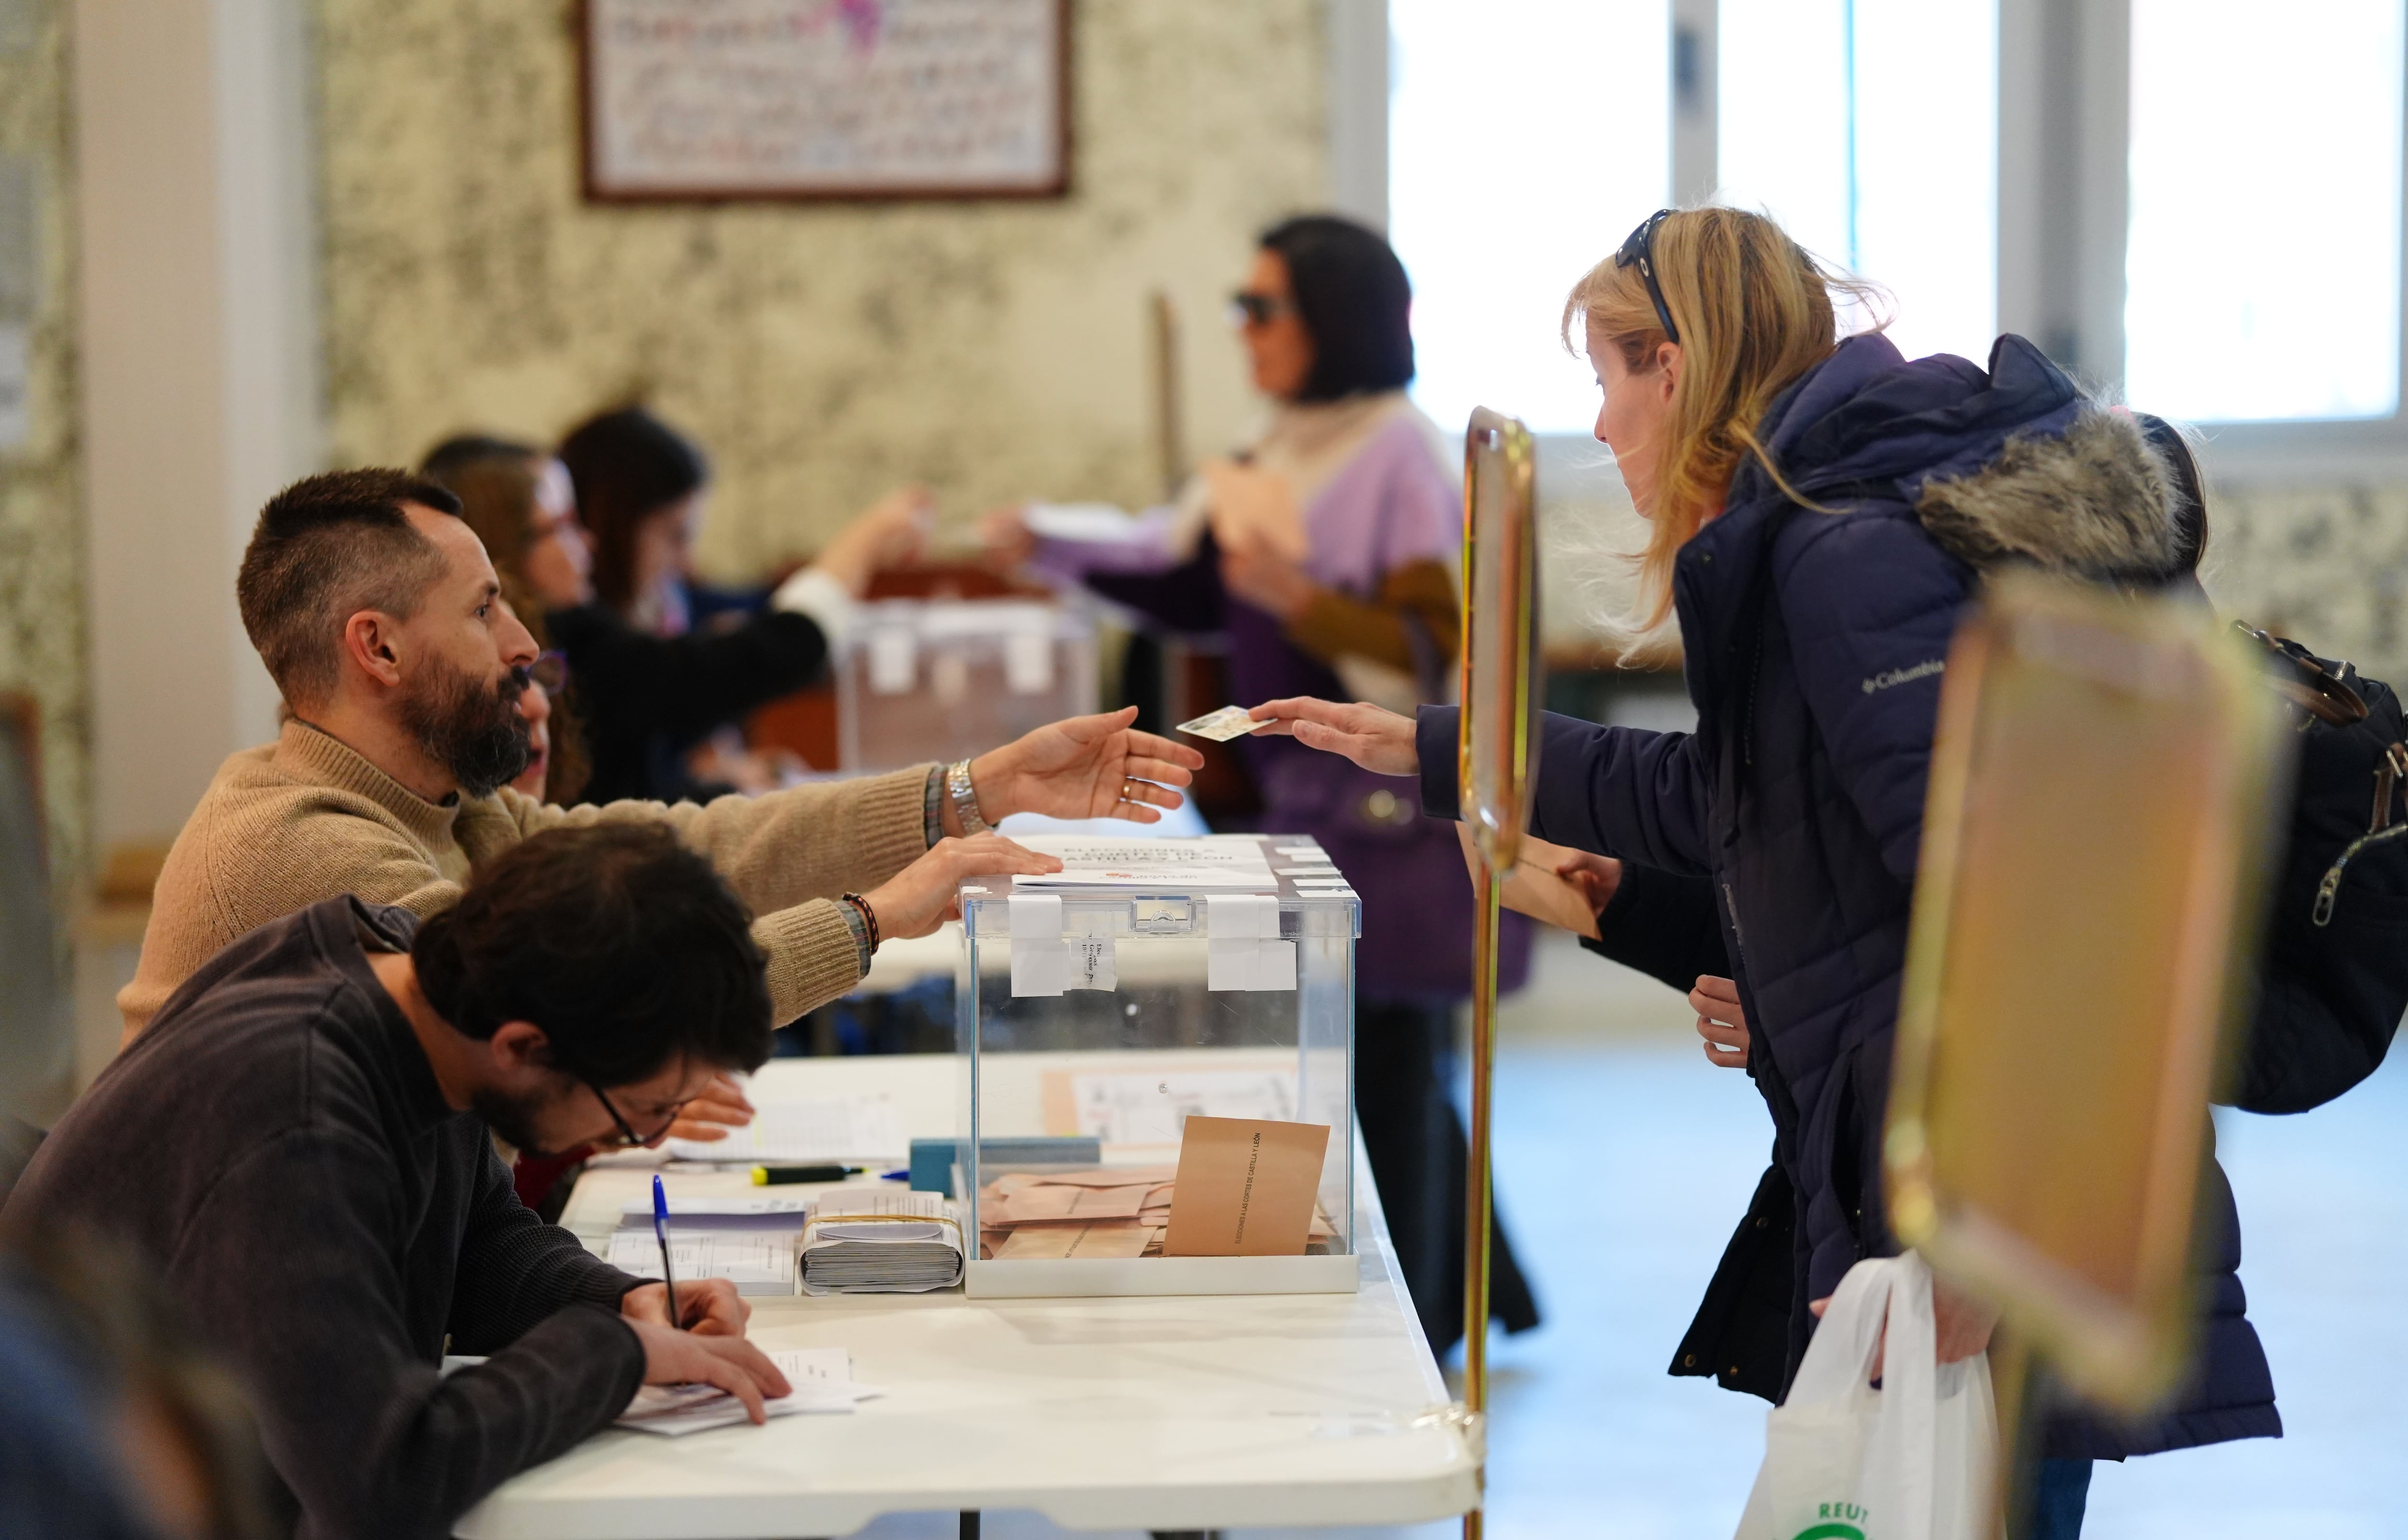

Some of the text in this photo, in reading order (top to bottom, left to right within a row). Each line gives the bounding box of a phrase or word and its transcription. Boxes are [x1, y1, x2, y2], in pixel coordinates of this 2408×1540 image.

[1875, 659, 1946, 690] Columbia
[1235, 1216, 1245, 1244] ELECCIONES
[1243, 1184, 1252, 1202] CORTES
[1248, 1153, 1257, 1175] CASTILLA
